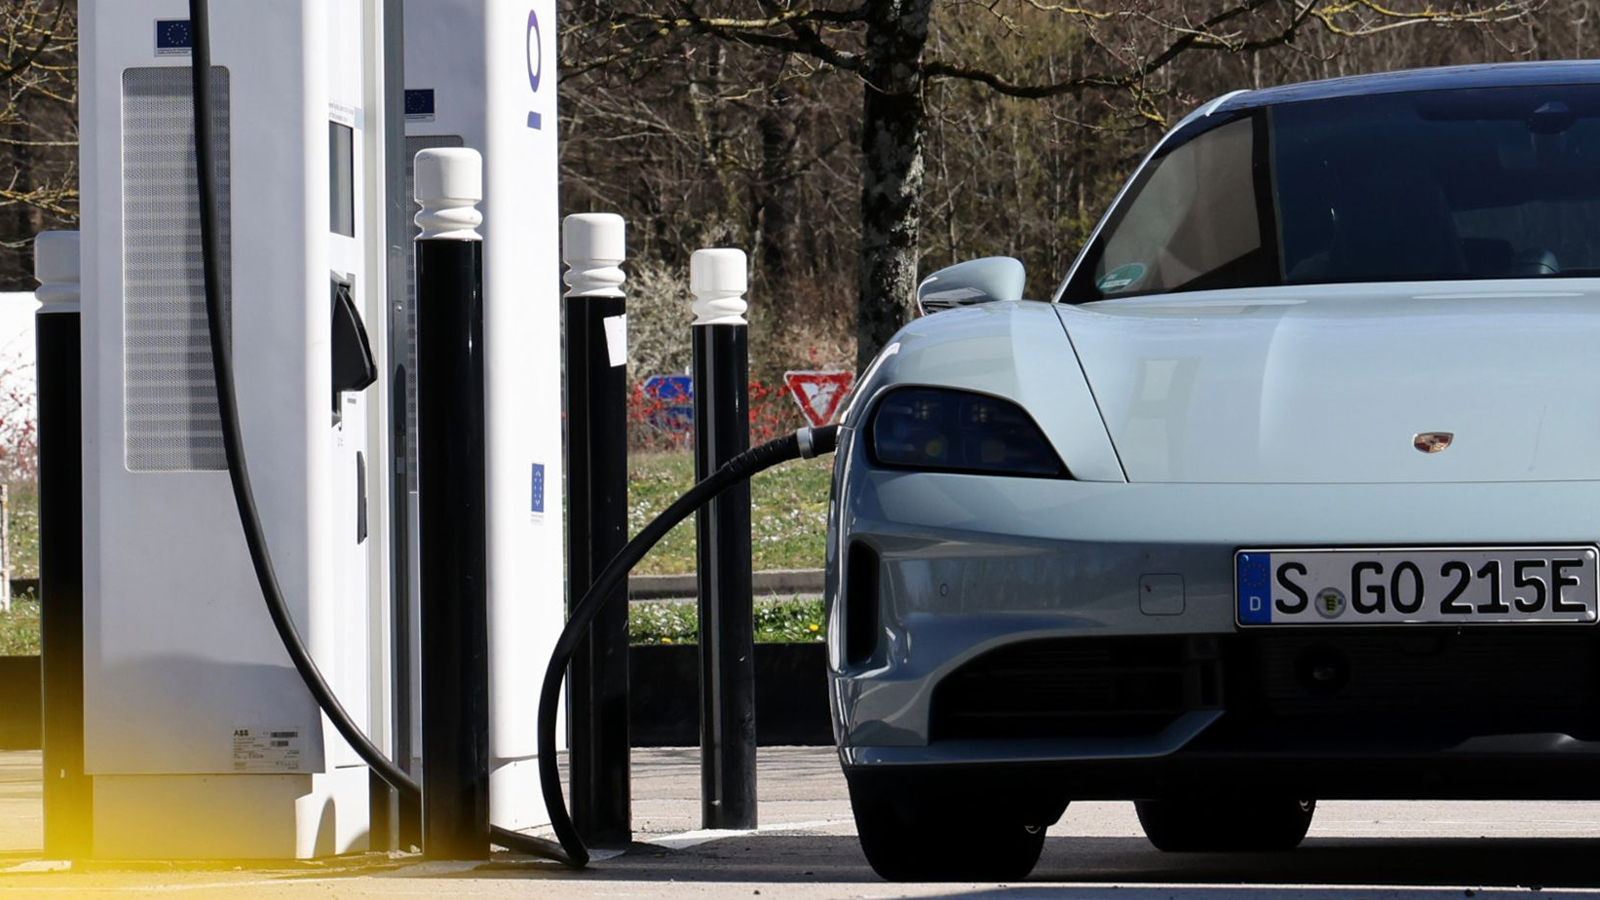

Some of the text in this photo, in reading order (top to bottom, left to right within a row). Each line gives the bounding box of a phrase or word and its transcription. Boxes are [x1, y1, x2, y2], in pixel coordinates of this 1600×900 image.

[1275, 558, 1587, 615] S GO 215E
[1250, 597, 1261, 612] D
[233, 729, 249, 737] ABB
